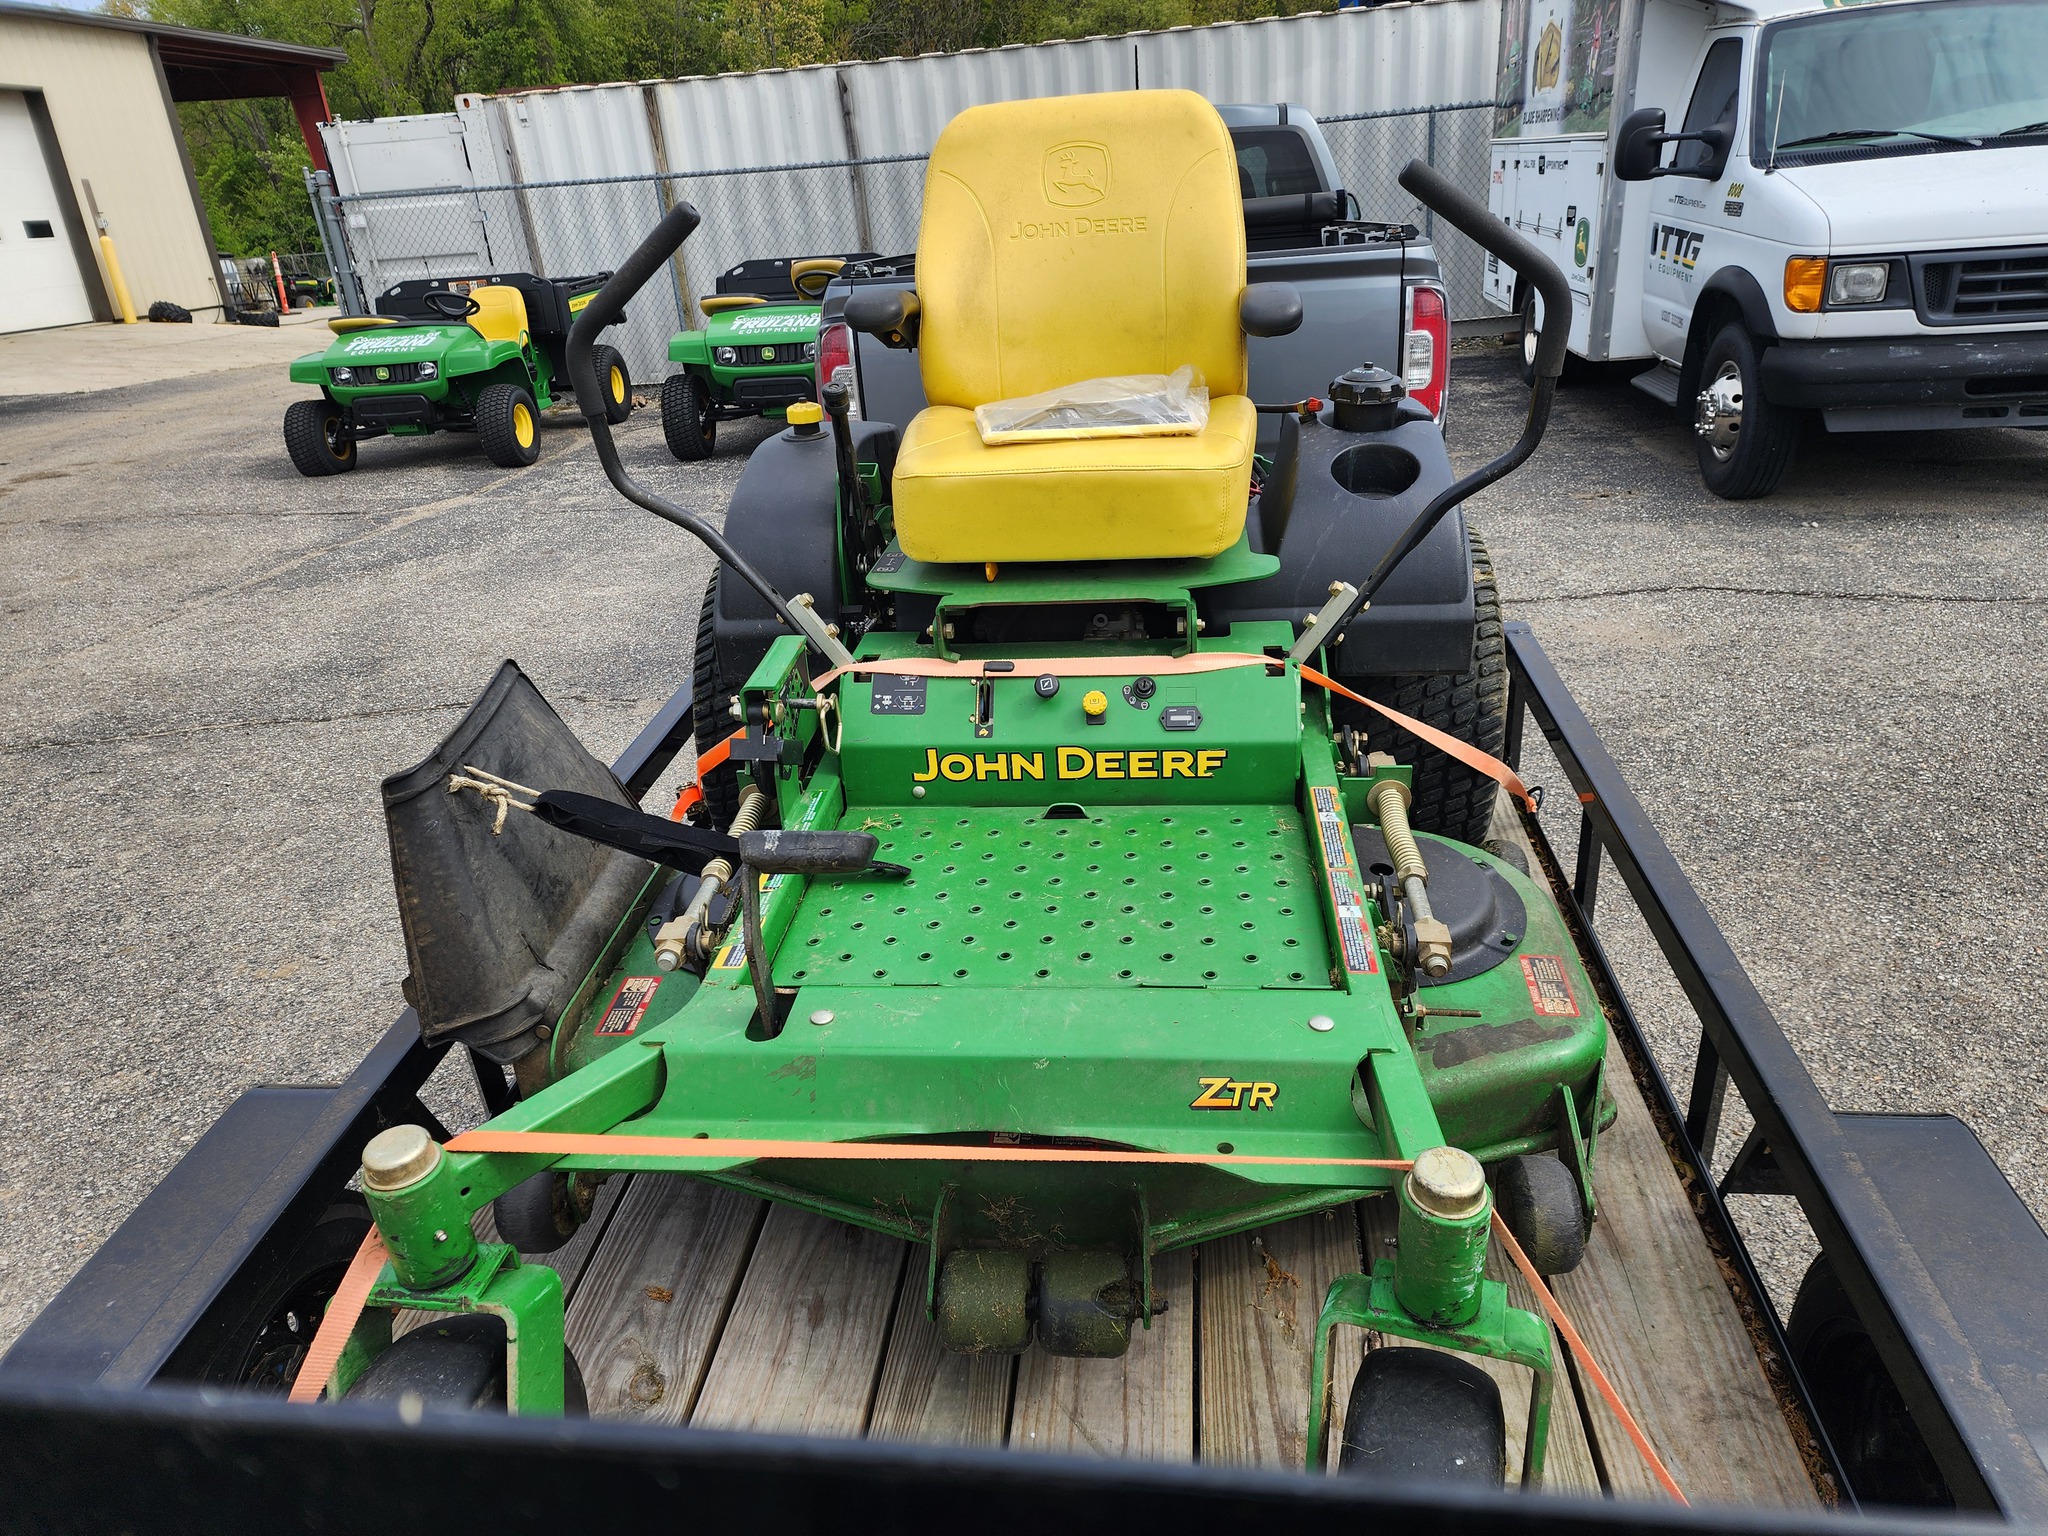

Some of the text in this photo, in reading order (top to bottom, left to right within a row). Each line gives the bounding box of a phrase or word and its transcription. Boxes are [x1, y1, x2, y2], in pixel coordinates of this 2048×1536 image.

[1009, 216, 1147, 241] JOHN DEERE
[1660, 224, 1705, 270] TTG
[1658, 263, 1693, 284] EQUIPMENT
[730, 316, 822, 330] TRULAND
[738, 327, 806, 335] EQUIPMENT
[344, 337, 437, 351] TRULAND
[350, 347, 416, 356] EQUIPMENT
[912, 745, 1228, 782] JOHN DEERE
[1189, 1077, 1280, 1111] ZTR
